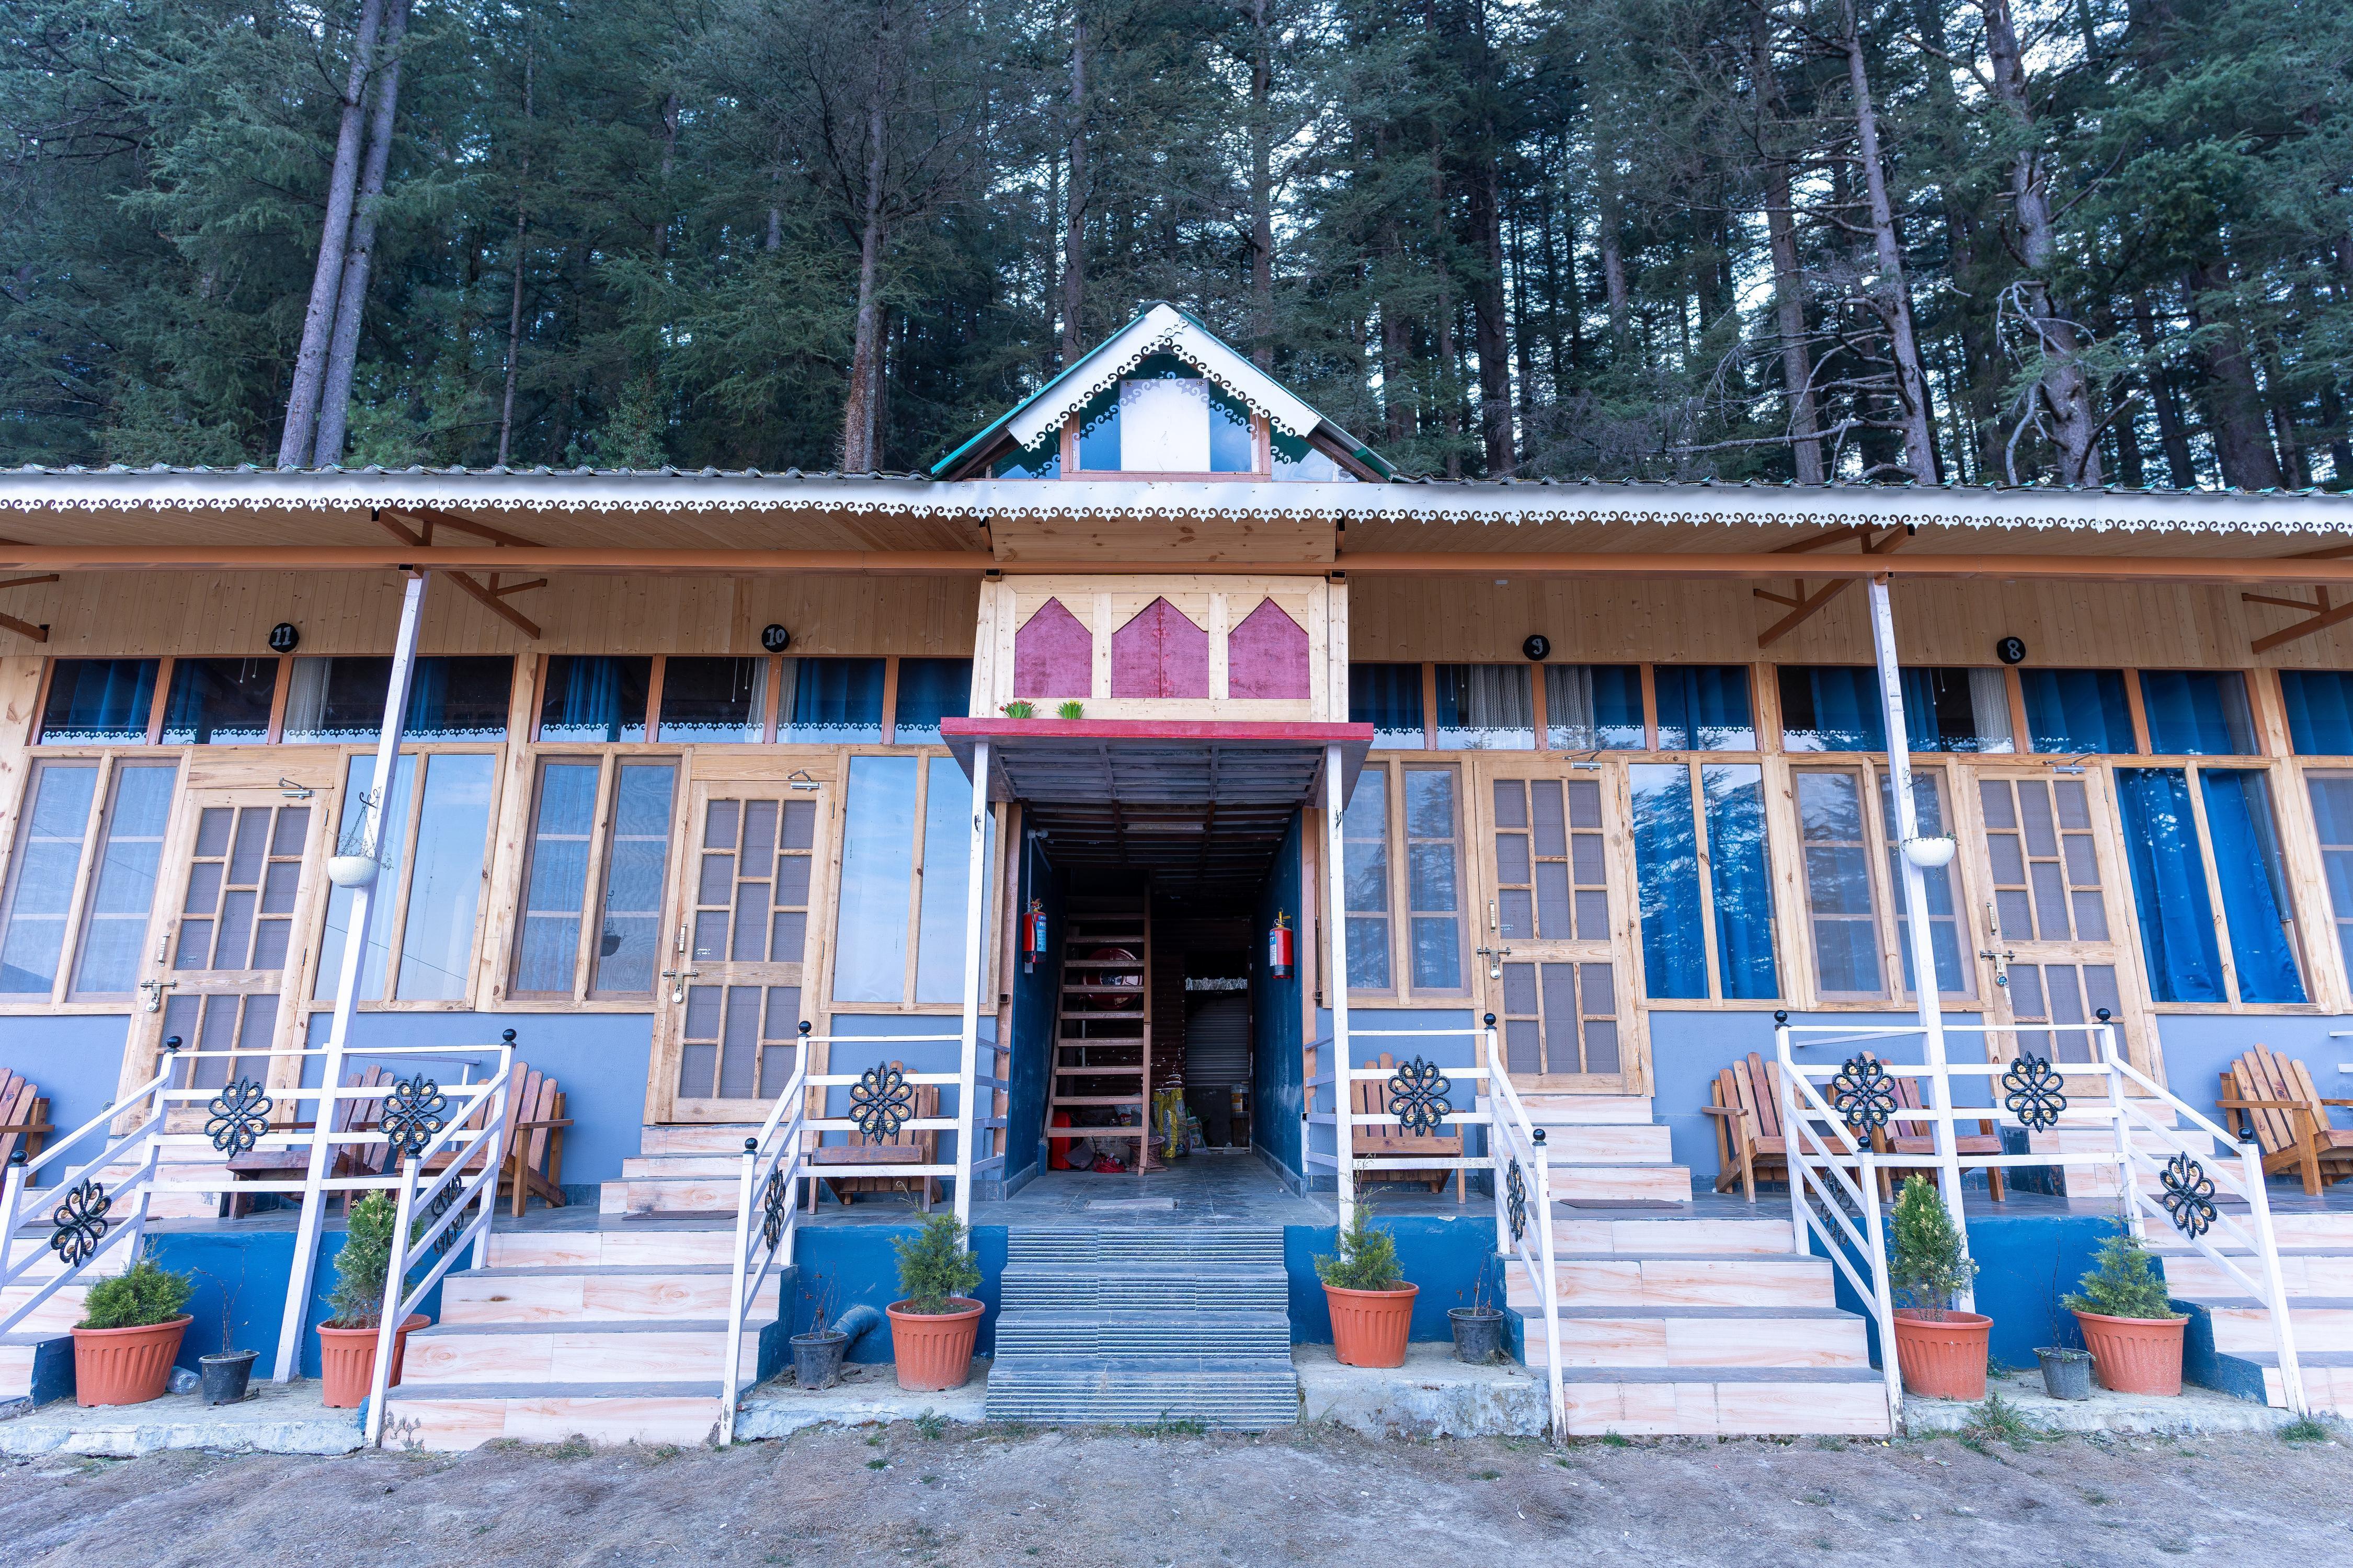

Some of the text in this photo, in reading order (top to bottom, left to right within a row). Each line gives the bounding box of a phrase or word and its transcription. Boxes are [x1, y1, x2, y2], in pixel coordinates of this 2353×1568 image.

[271, 626, 292, 646] 11
[766, 627, 786, 646] 10
[1532, 638, 1543, 655] 9
[2007, 639, 2021, 659] 8
